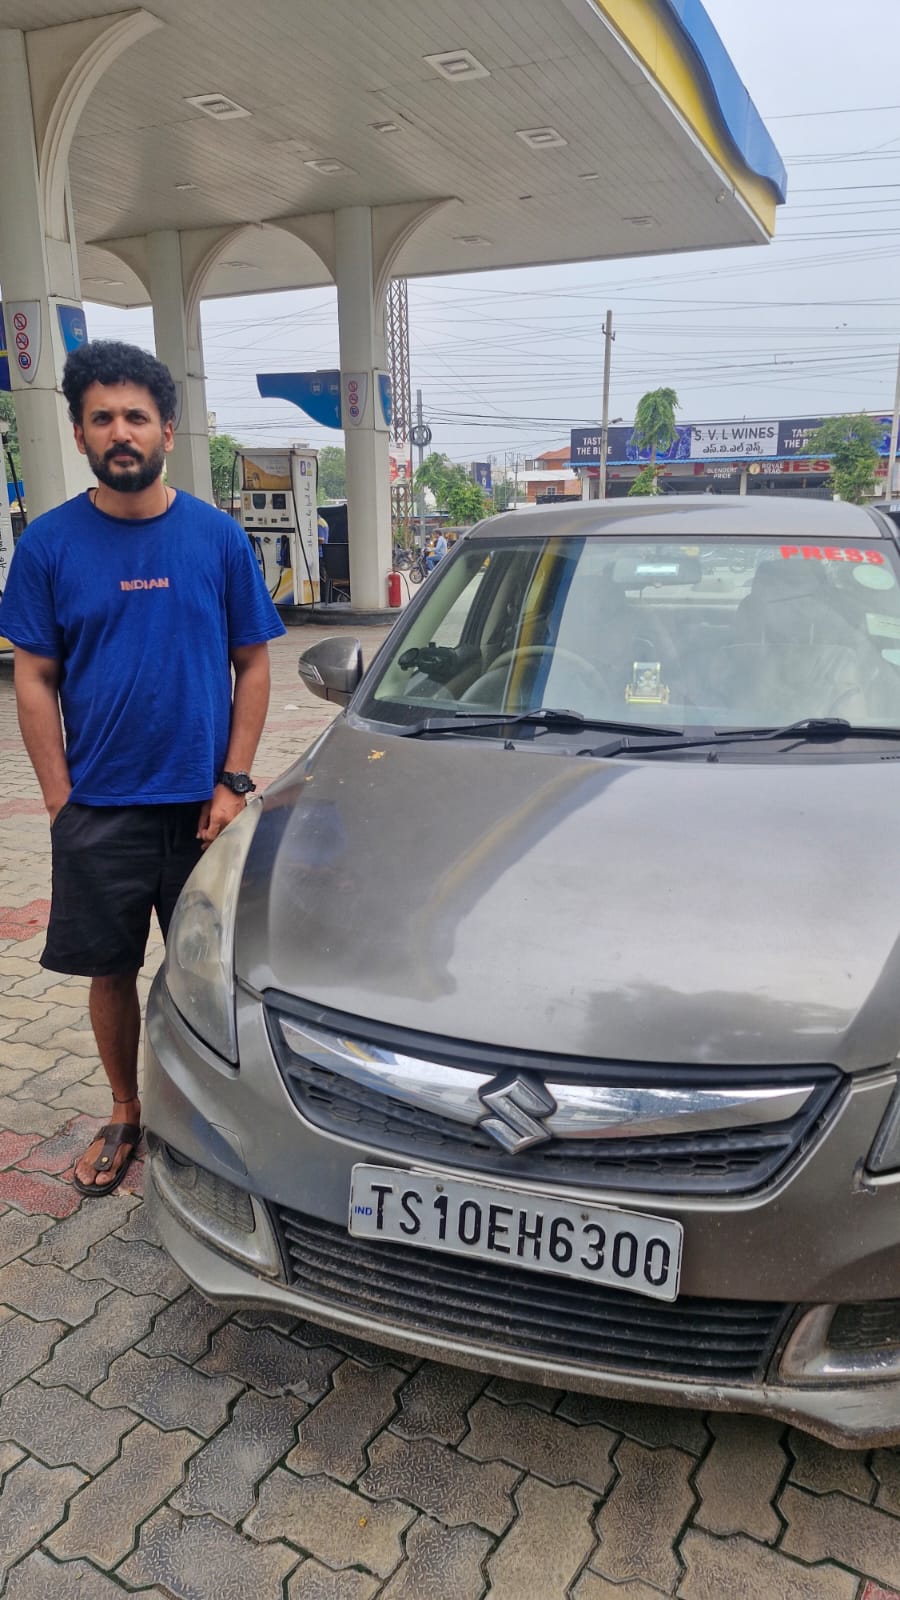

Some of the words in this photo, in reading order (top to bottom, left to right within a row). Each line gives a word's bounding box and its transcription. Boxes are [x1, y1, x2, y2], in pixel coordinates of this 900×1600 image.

[722, 428, 729, 440] L
[731, 426, 775, 440] WINES
[583, 437, 602, 447] TAST
[784, 439, 800, 449] THE
[577, 447, 591, 456] THE
[780, 545, 885, 566] PRESS
[120, 577, 169, 591] INDIAN
[354, 1205, 373, 1216] IND
[370, 1184, 671, 1286] TS10EH6300
